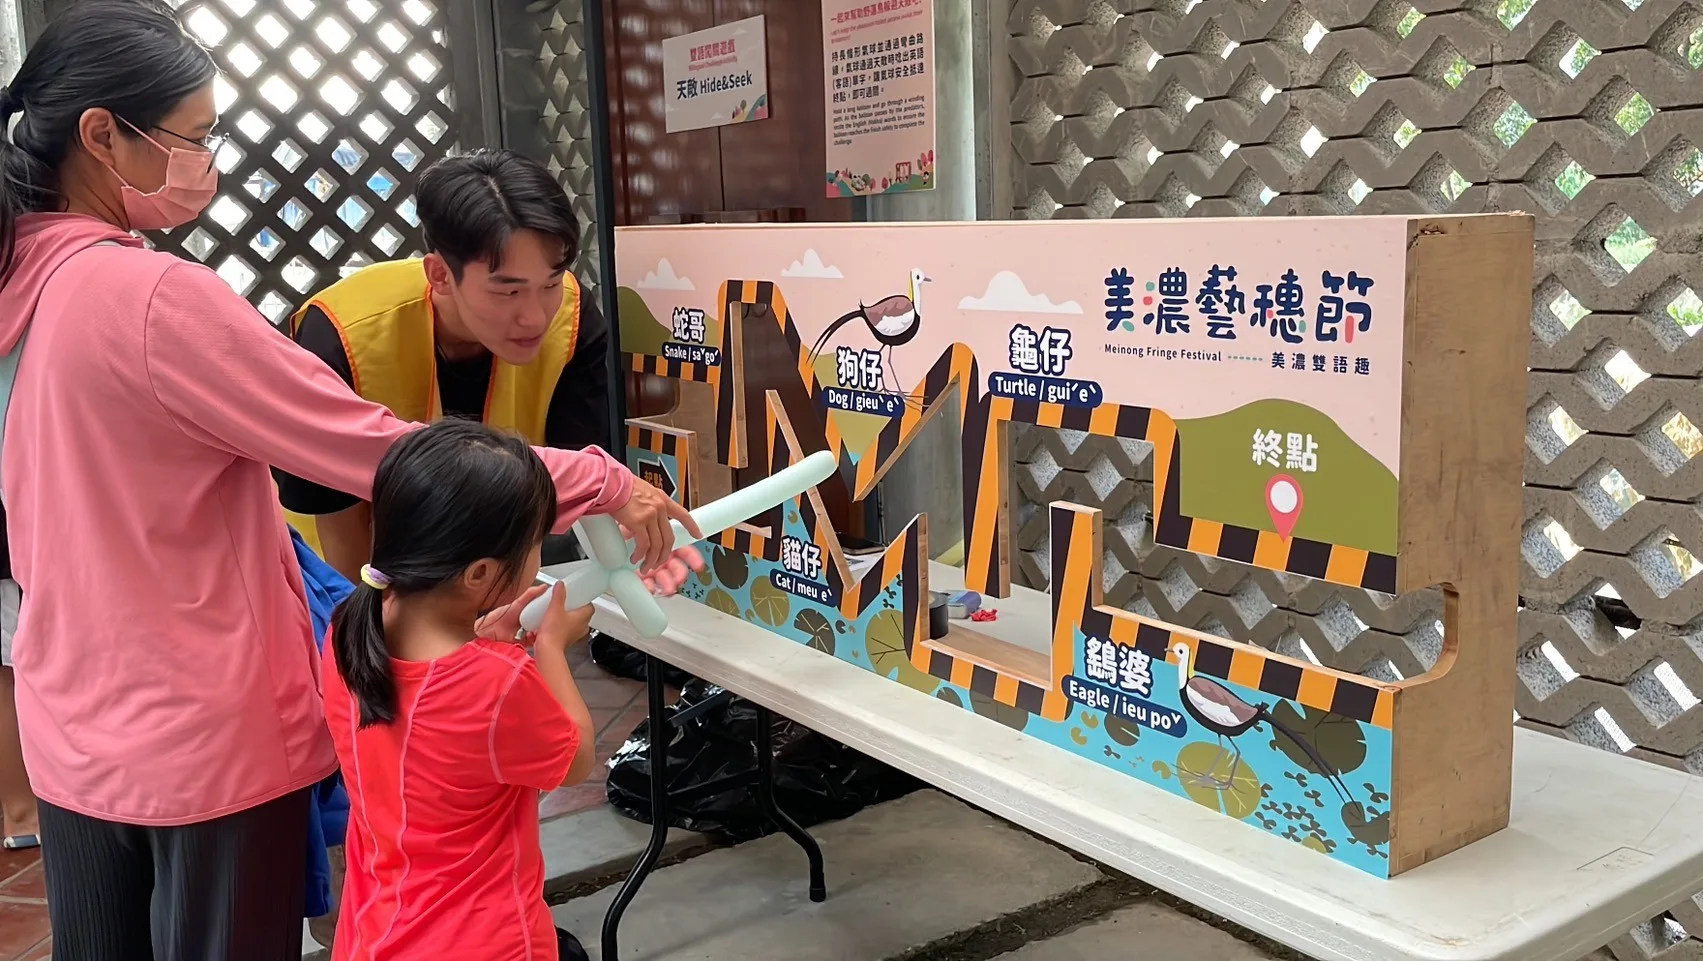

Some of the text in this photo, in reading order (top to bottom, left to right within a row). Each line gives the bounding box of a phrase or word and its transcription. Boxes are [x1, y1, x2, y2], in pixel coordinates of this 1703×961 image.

[676, 70, 752, 100] 天敵 Hide&Seek
[1104, 263, 1375, 344] 美濃藝穗節
[673, 308, 706, 343] 蛇哥
[664, 345, 688, 360] Snake
[1010, 325, 1072, 374] 龜仔
[1104, 343, 1222, 362] Meinong Fringe Festival
[1271, 352, 1371, 375] 美濃雙語趣
[837, 347, 882, 388] 狗仔
[828, 389, 848, 409] Dog
[995, 376, 1037, 397] Turtle
[1252, 428, 1318, 472] 終點
[782, 537, 822, 578] 貓仔
[775, 573, 791, 590] Cat
[797, 582, 818, 599] meu
[1069, 679, 1110, 708] Eagle
[1122, 696, 1147, 721] ieu
